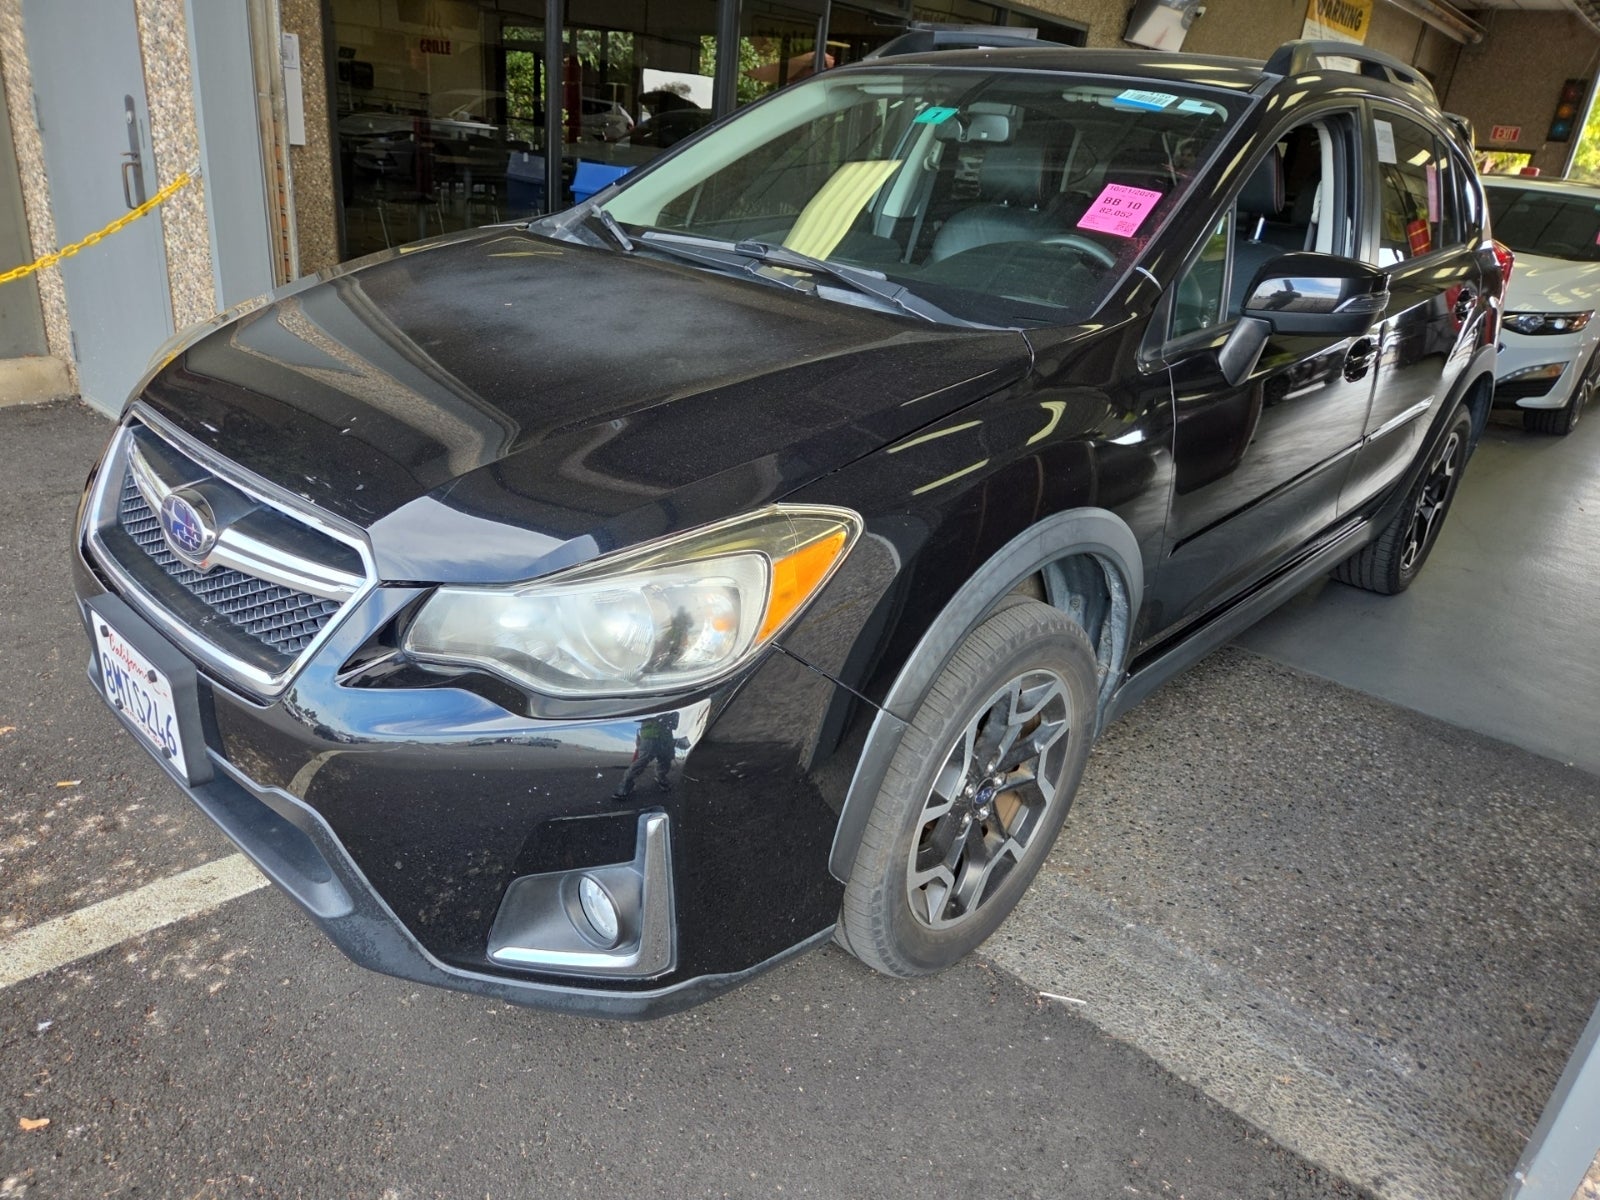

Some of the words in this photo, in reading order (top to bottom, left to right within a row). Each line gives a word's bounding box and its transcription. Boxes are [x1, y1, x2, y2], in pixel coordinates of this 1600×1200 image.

[1495, 127, 1517, 140] EXIT
[1103, 196, 1122, 206] BB
[1126, 201, 1142, 210] 10
